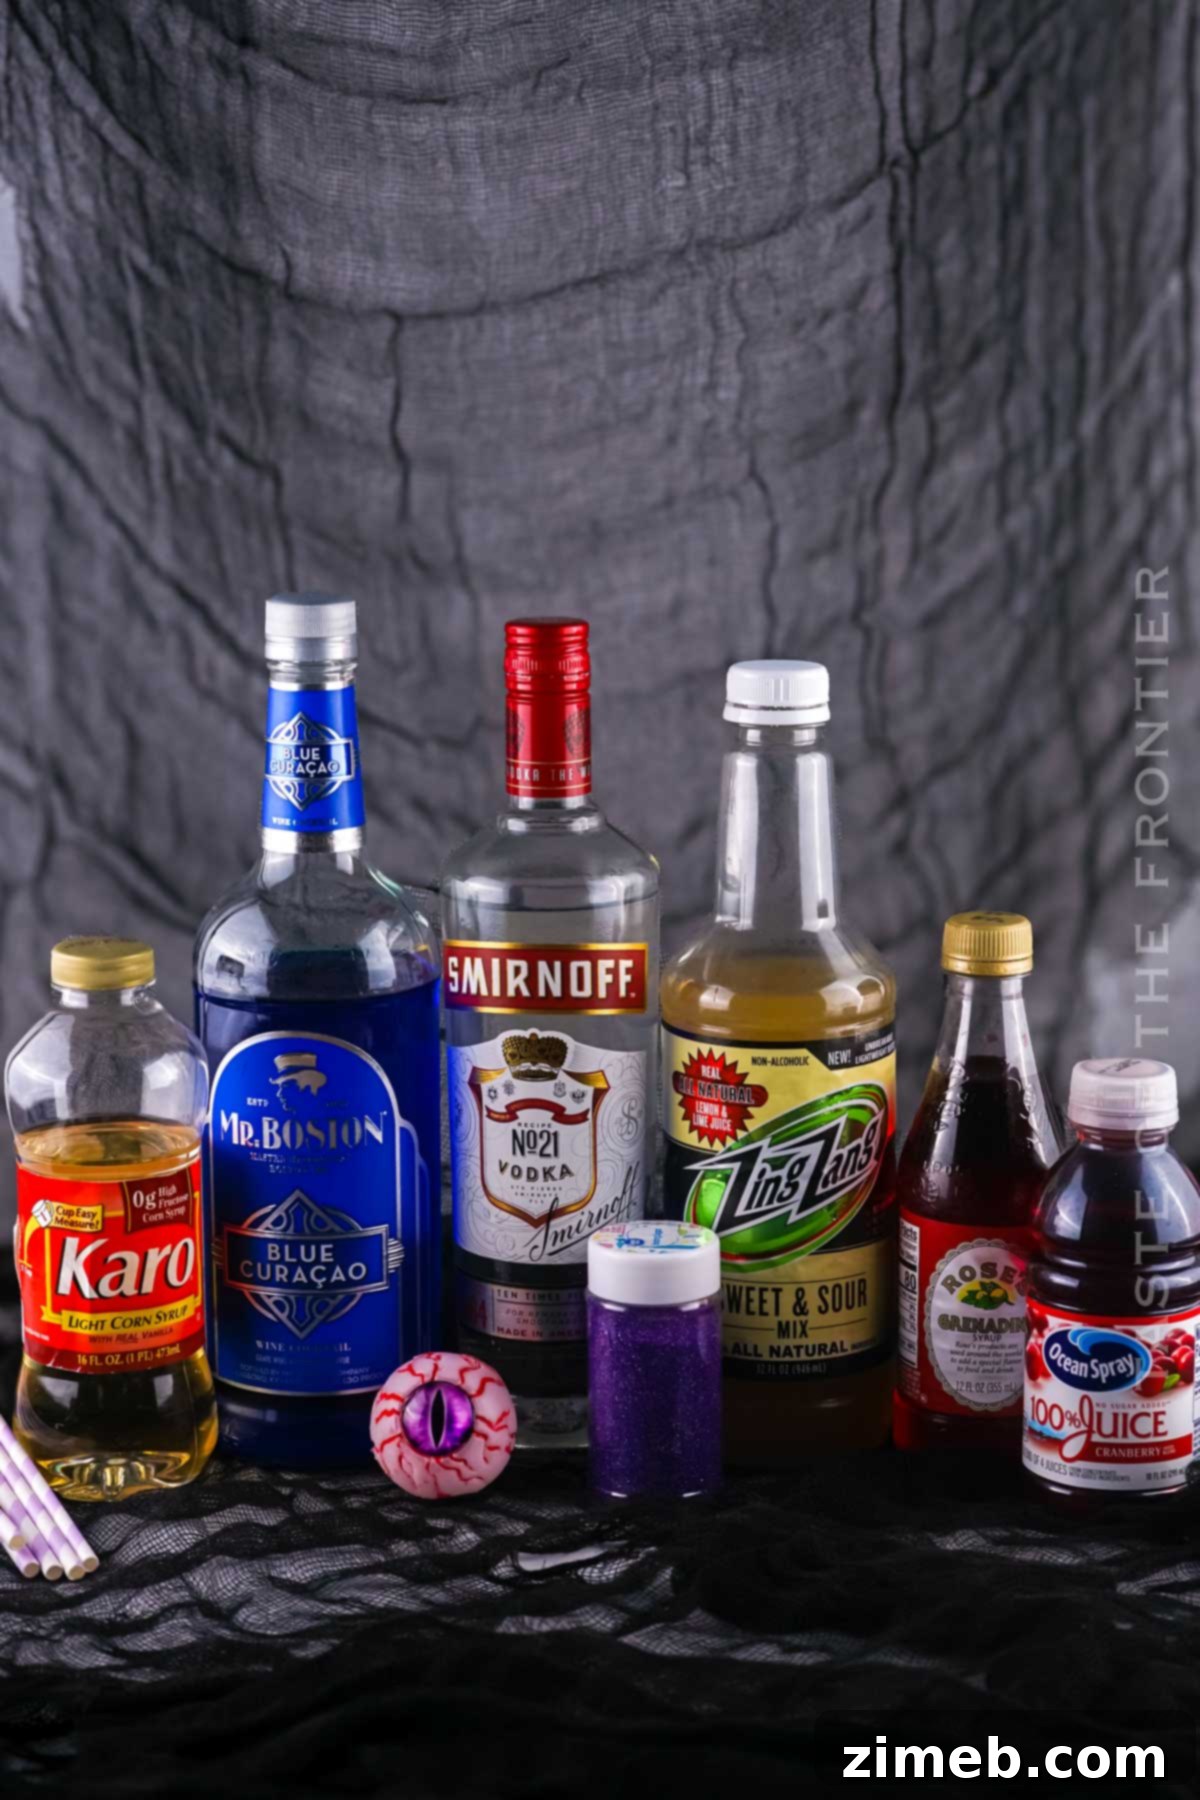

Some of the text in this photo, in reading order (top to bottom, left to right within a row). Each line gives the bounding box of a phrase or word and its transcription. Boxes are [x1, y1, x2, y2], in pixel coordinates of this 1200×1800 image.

[283, 747, 321, 761] BLUE
[271, 760, 341, 778] CURAÇAO
[447, 955, 635, 999] SMIRNOFF
[751, 1049, 852, 1066] NON-ALCOHOLIC NEW!
[700, 1064, 721, 1080] REAL
[697, 1080, 754, 1105] NATURAL
[695, 1100, 720, 1116] LEMON
[693, 1112, 733, 1132] LIME JUICE
[498, 1159, 575, 1183] VODKA
[132, 1184, 177, 1210] 0g High
[55, 1205, 98, 1220] Cup Easy
[142, 1205, 186, 1223] Corn Syrup
[524, 1161, 640, 1262] Smirnoff
[54, 1216, 100, 1230] Measure!
[267, 1243, 334, 1263] BLUE
[57, 1235, 195, 1300] Karo
[239, 1260, 368, 1289] CURAÇAO
[496, 1288, 519, 1299] TEN
[720, 1277, 868, 1317] WEET & SOUR
[67, 1315, 107, 1331] LIGHT
[109, 1315, 153, 1330] CORN
[154, 1304, 189, 1325] SYRUP
[937, 1313, 1028, 1334] GRENADIN
[496, 1326, 528, 1337] MADE
[531, 1328, 544, 1338] IN
[777, 1320, 809, 1340] MIX
[972, 1334, 1002, 1342] SYRUP
[731, 1342, 764, 1358] ALL
[768, 1340, 849, 1359] NATURAL
[1048, 1342, 1135, 1384] Ocean Spray
[956, 1380, 965, 1392] 12
[966, 1381, 974, 1392] FL
[975, 1382, 986, 1393] OZ
[1031, 1395, 1081, 1431] 100%
[1058, 1394, 1168, 1462] JUICE
[1095, 1445, 1161, 1458] CRANBERRY
[1045, 1458, 1067, 1476] JUICES
